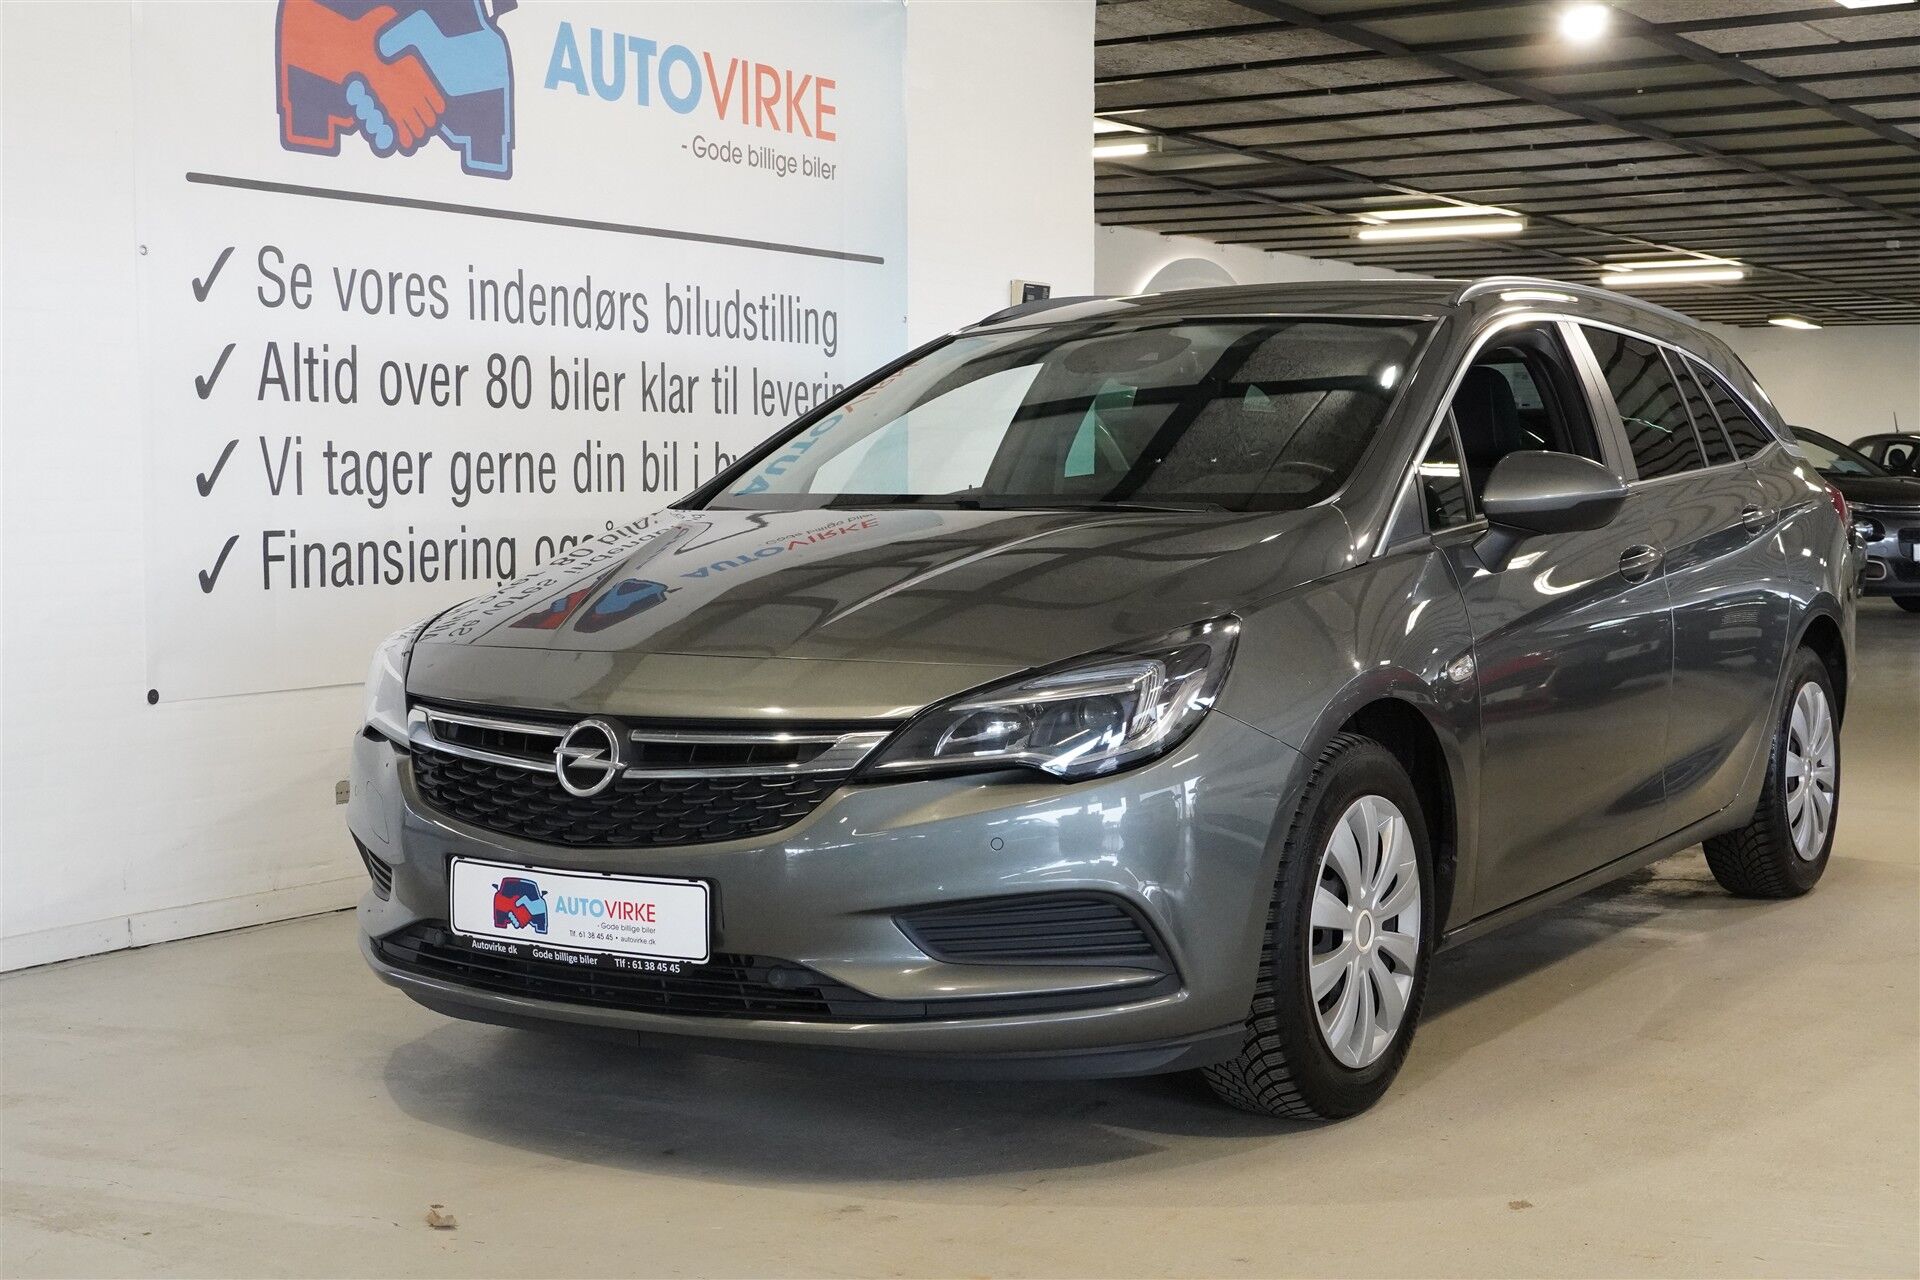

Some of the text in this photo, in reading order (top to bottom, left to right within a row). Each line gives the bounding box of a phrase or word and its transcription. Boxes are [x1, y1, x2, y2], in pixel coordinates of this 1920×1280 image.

[544, 20, 837, 142] AUTOVIRKE
[692, 134, 743, 165] Gode
[748, 144, 797, 178] billige
[802, 154, 837, 180] biler
[257, 245, 839, 357] Se vores indendørs biludstilling
[257, 341, 358, 405] Altid
[379, 360, 469, 407] over
[486, 352, 532, 410] 80
[550, 355, 626, 412] biler
[641, 360, 700, 414] klar
[711, 365, 738, 415] til
[259, 435, 304, 496] Vi
[322, 440, 433, 510] tager
[450, 451, 556, 508] gerne
[573, 439, 625, 494] din
[642, 440, 678, 493] bil
[693, 441, 699, 489] i
[262, 524, 516, 587] Finansiering
[555, 895, 656, 923] AUTOVIRKE
[471, 939, 518, 955] Autovirke dk
[578, 930, 586, 938] 61
[588, 931, 596, 940] 38
[596, 932, 605, 940] 45
[605, 933, 614, 941] 45
[600, 922, 620, 931] Gode
[620, 924, 640, 935] billige
[641, 926, 656, 935] biler
[532, 948, 598, 966] Gode billige biler
[632, 960, 643, 970] 61
[644, 961, 655, 971] 38
[656, 962, 668, 972] 45
[669, 963, 680, 973] 45
